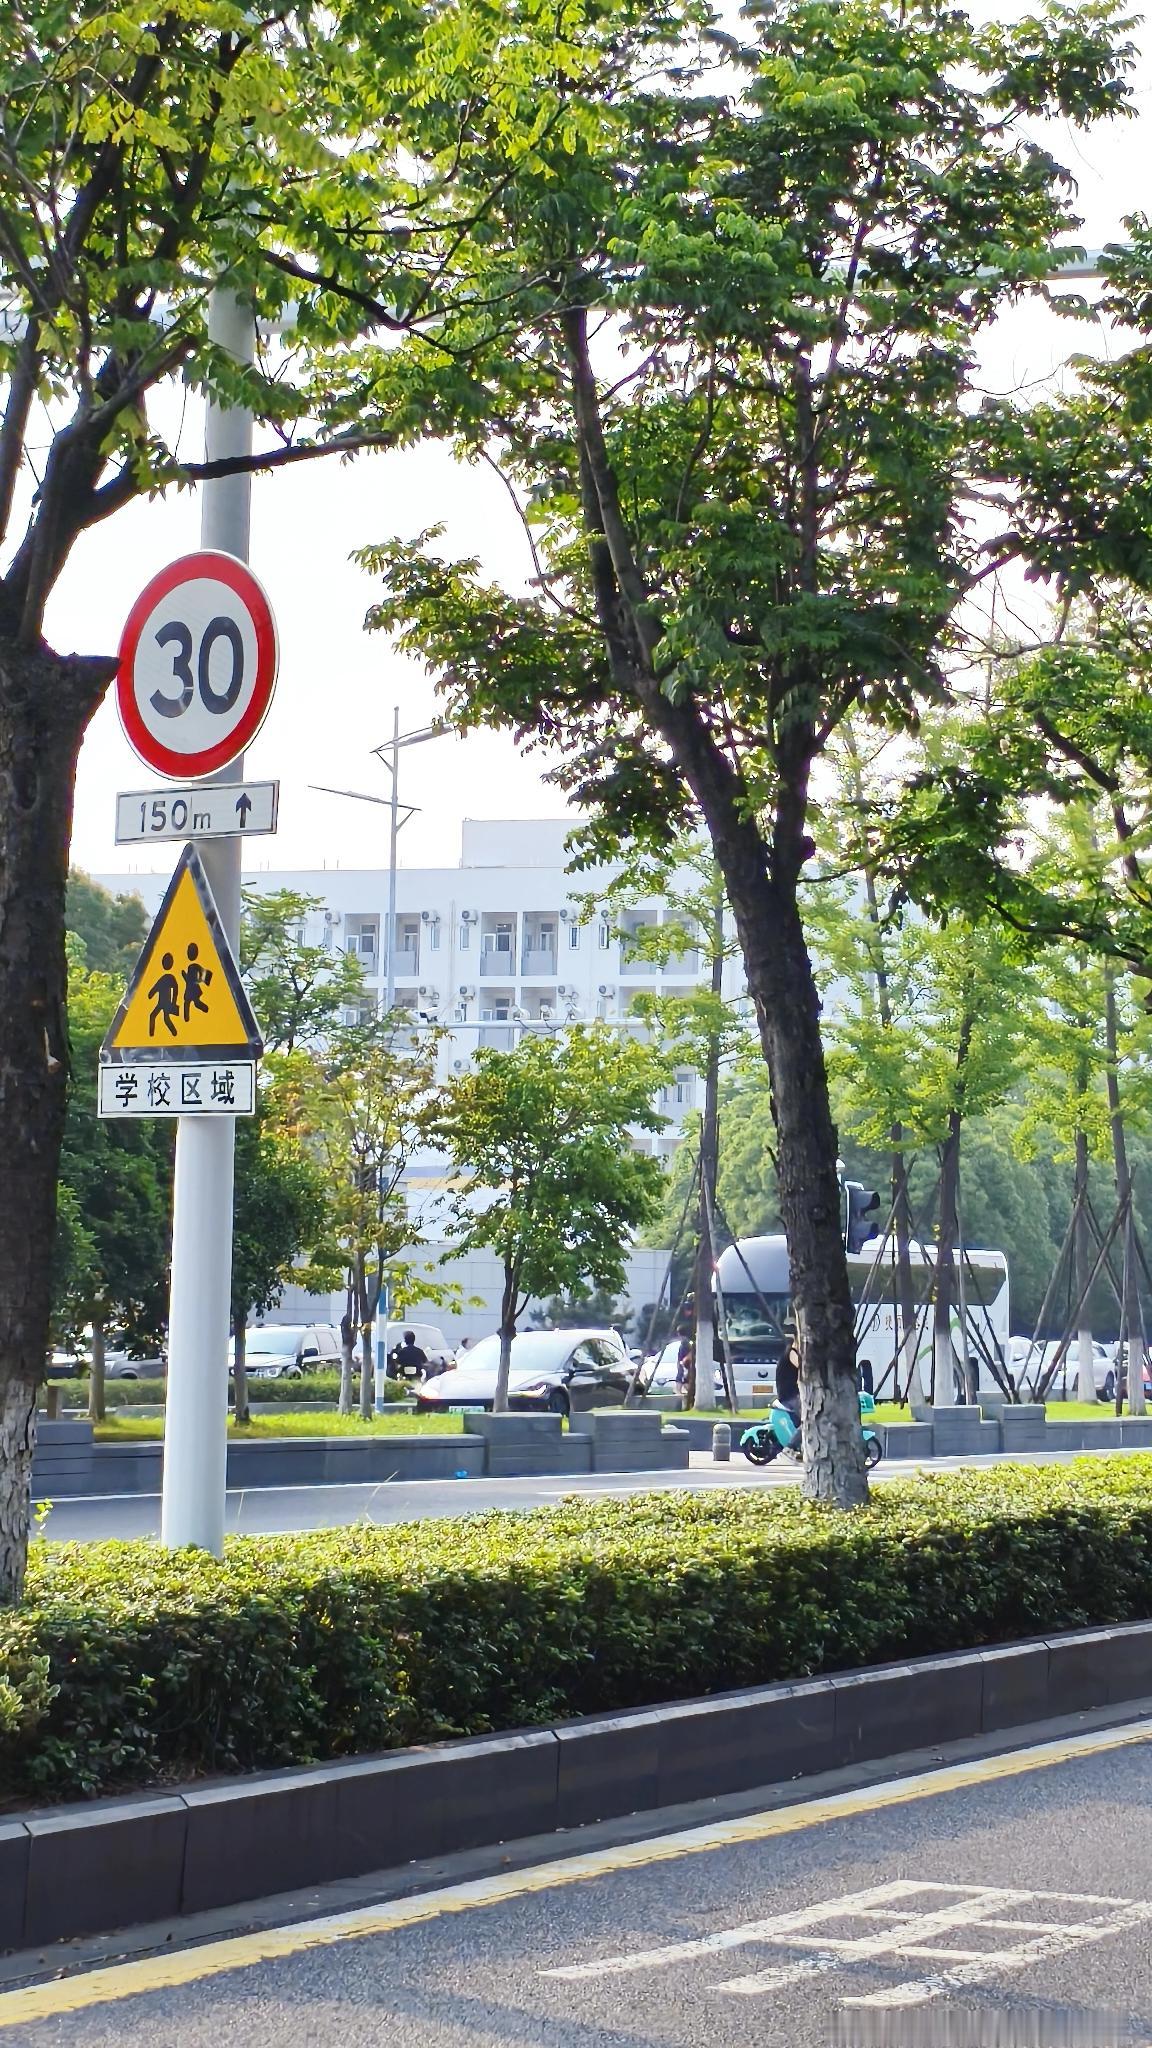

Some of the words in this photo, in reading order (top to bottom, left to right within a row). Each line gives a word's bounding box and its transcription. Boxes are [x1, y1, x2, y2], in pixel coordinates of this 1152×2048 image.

[150, 616, 244, 718] 30
[140, 799, 211, 833] 150m
[115, 1069, 235, 1108] 学校区域
